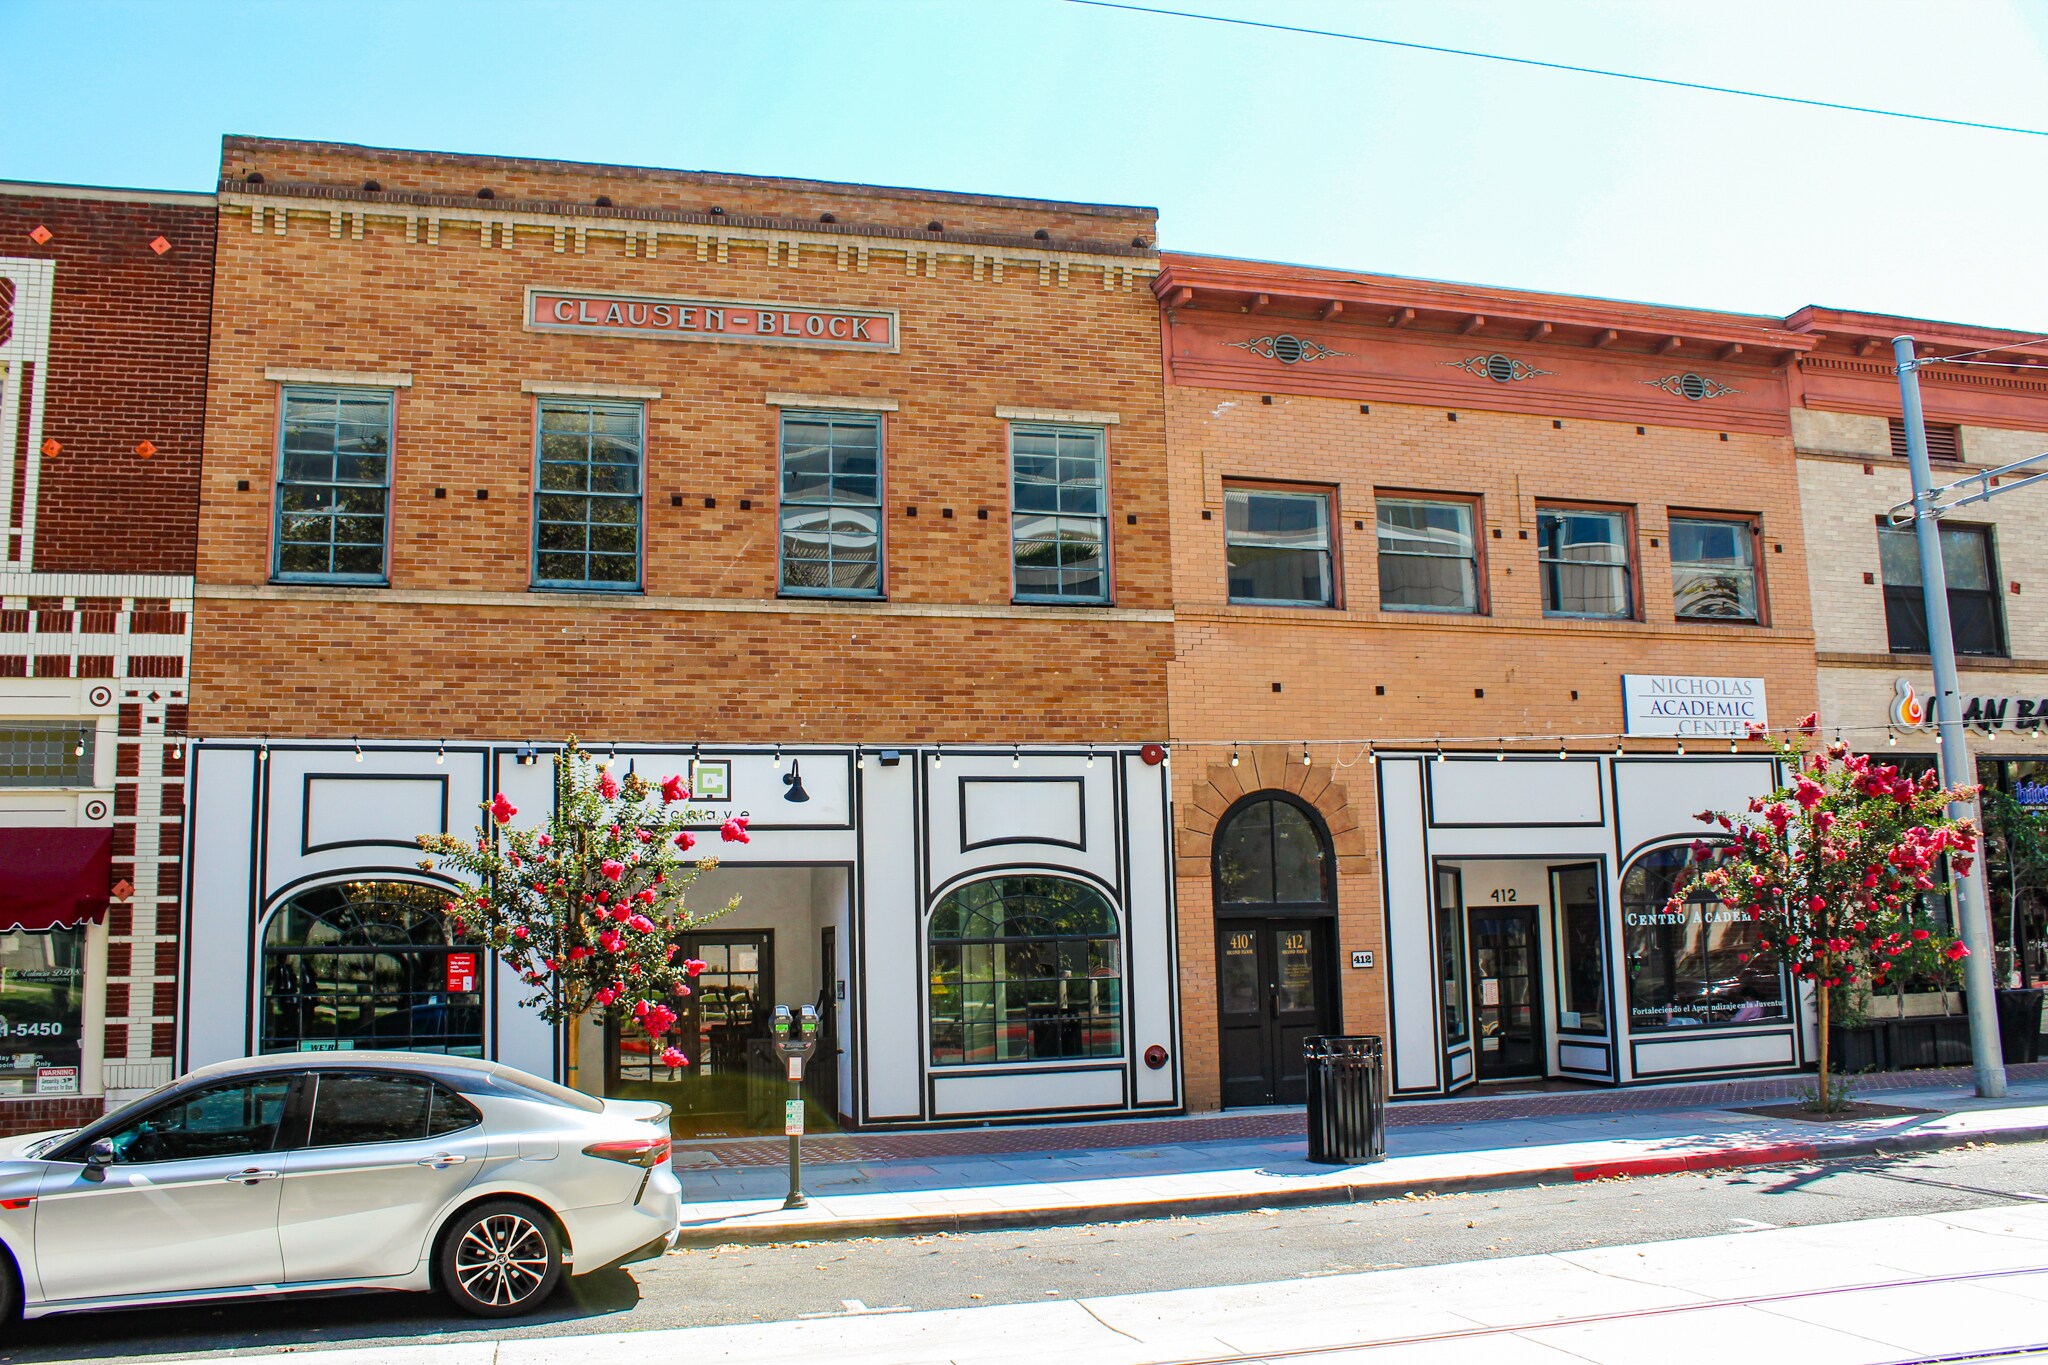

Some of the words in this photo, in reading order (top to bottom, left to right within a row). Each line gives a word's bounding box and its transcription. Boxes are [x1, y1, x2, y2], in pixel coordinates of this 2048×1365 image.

[554, 300, 871, 339] CLAUSEN-BLOCK
[1651, 678, 1752, 696] NICHOLAS
[1650, 700, 1754, 717] ACADEMIC
[1491, 889, 1516, 902] 412
[1627, 912, 1685, 926] CENTRO
[1230, 934, 1248, 949] 410
[1285, 934, 1303, 949] 412
[1353, 955, 1371, 964] 412
[1632, 1006, 1682, 1016] Fortaleciendo
[1683, 1005, 1690, 1013] el
[35, 1060, 52, 1068] Only
